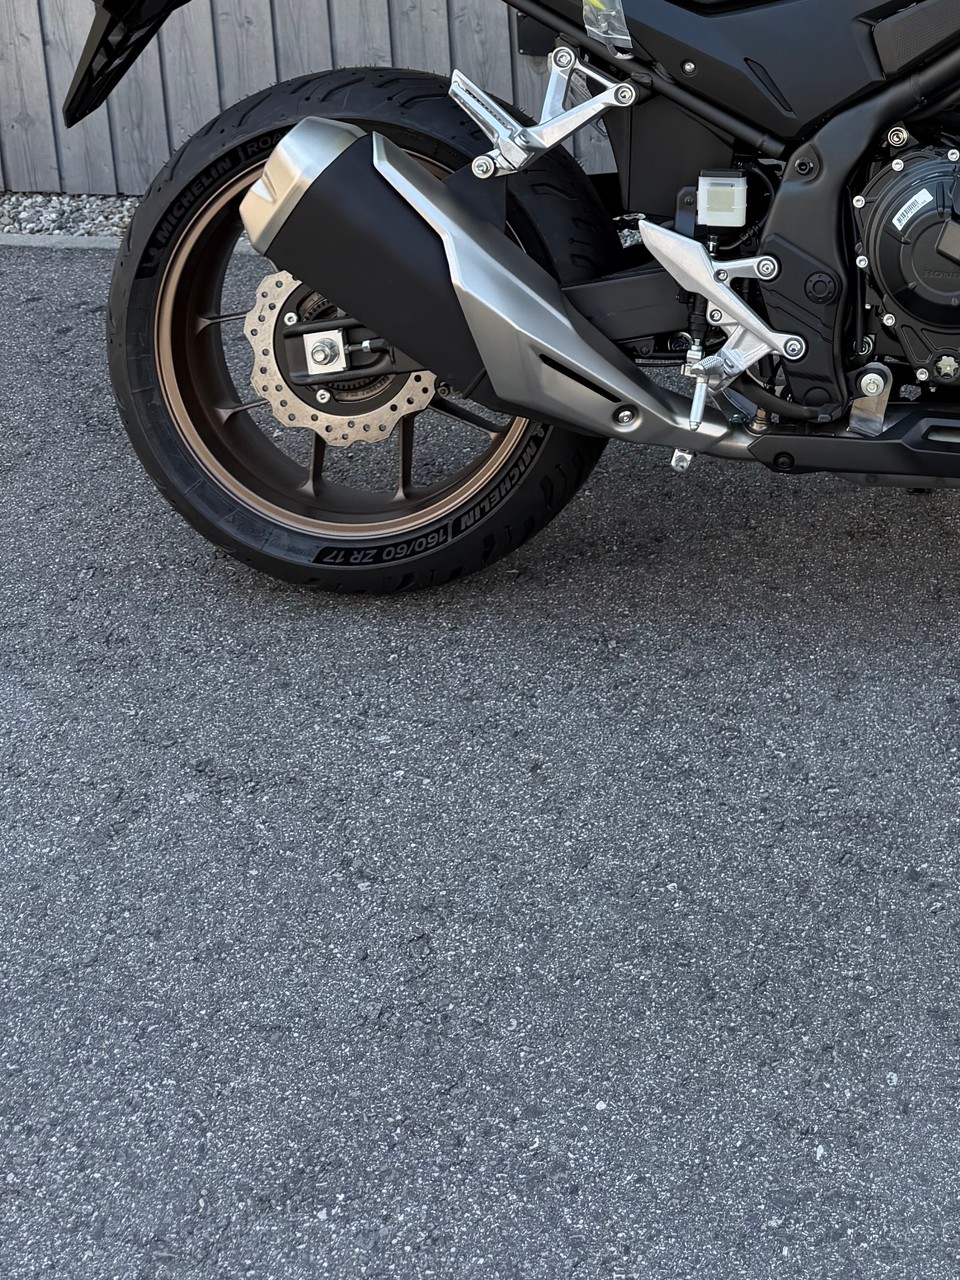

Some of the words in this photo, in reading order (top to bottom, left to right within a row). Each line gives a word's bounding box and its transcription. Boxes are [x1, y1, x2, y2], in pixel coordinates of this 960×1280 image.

[155, 156, 233, 245] MICHELIN
[247, 132, 284, 157] ROA
[459, 439, 538, 531] MICHELIN
[322, 548, 346, 564] 17
[349, 548, 377, 564] ZR
[382, 529, 447, 561] 160/60
